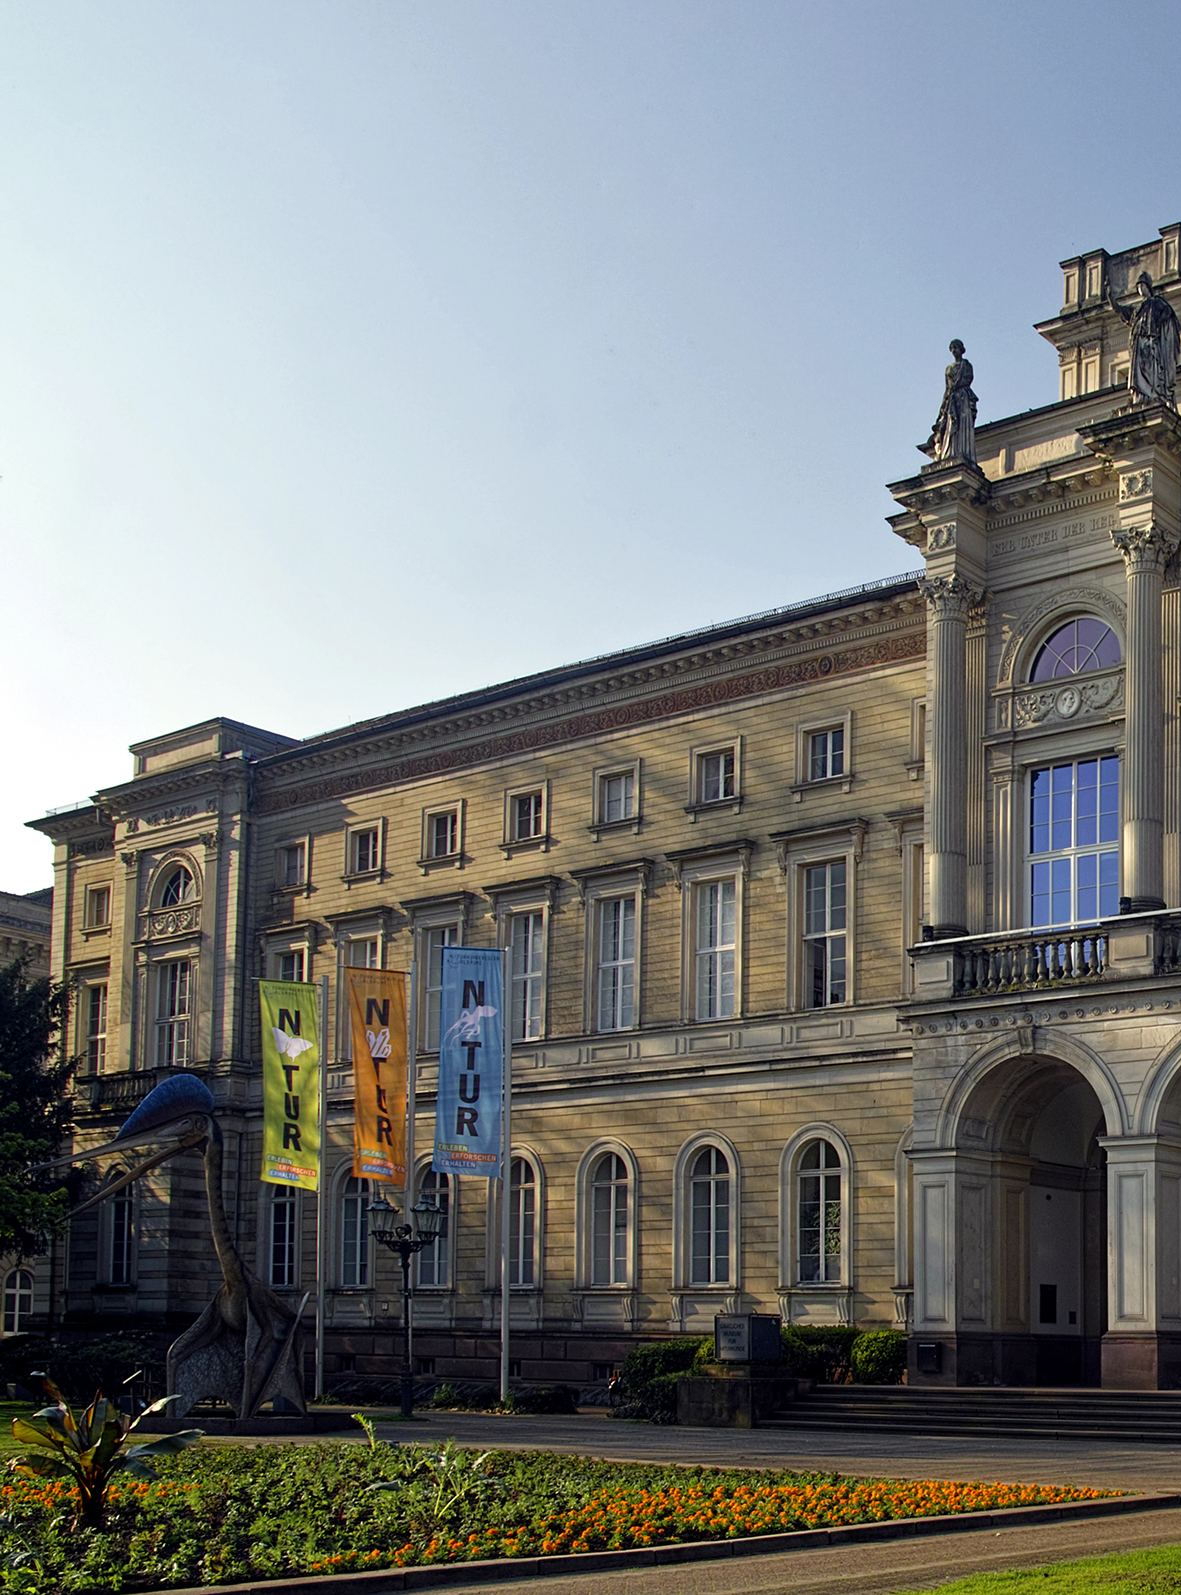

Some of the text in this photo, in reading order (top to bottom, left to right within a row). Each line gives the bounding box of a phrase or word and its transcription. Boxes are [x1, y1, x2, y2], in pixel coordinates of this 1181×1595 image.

[1021, 529, 1058, 549] UNTER
[1062, 522, 1085, 539] DER
[438, 1143, 468, 1152] ERLEBEN
[451, 1152, 497, 1161] ERFORSCHEN
[441, 1160, 476, 1168] ERHALTEN
